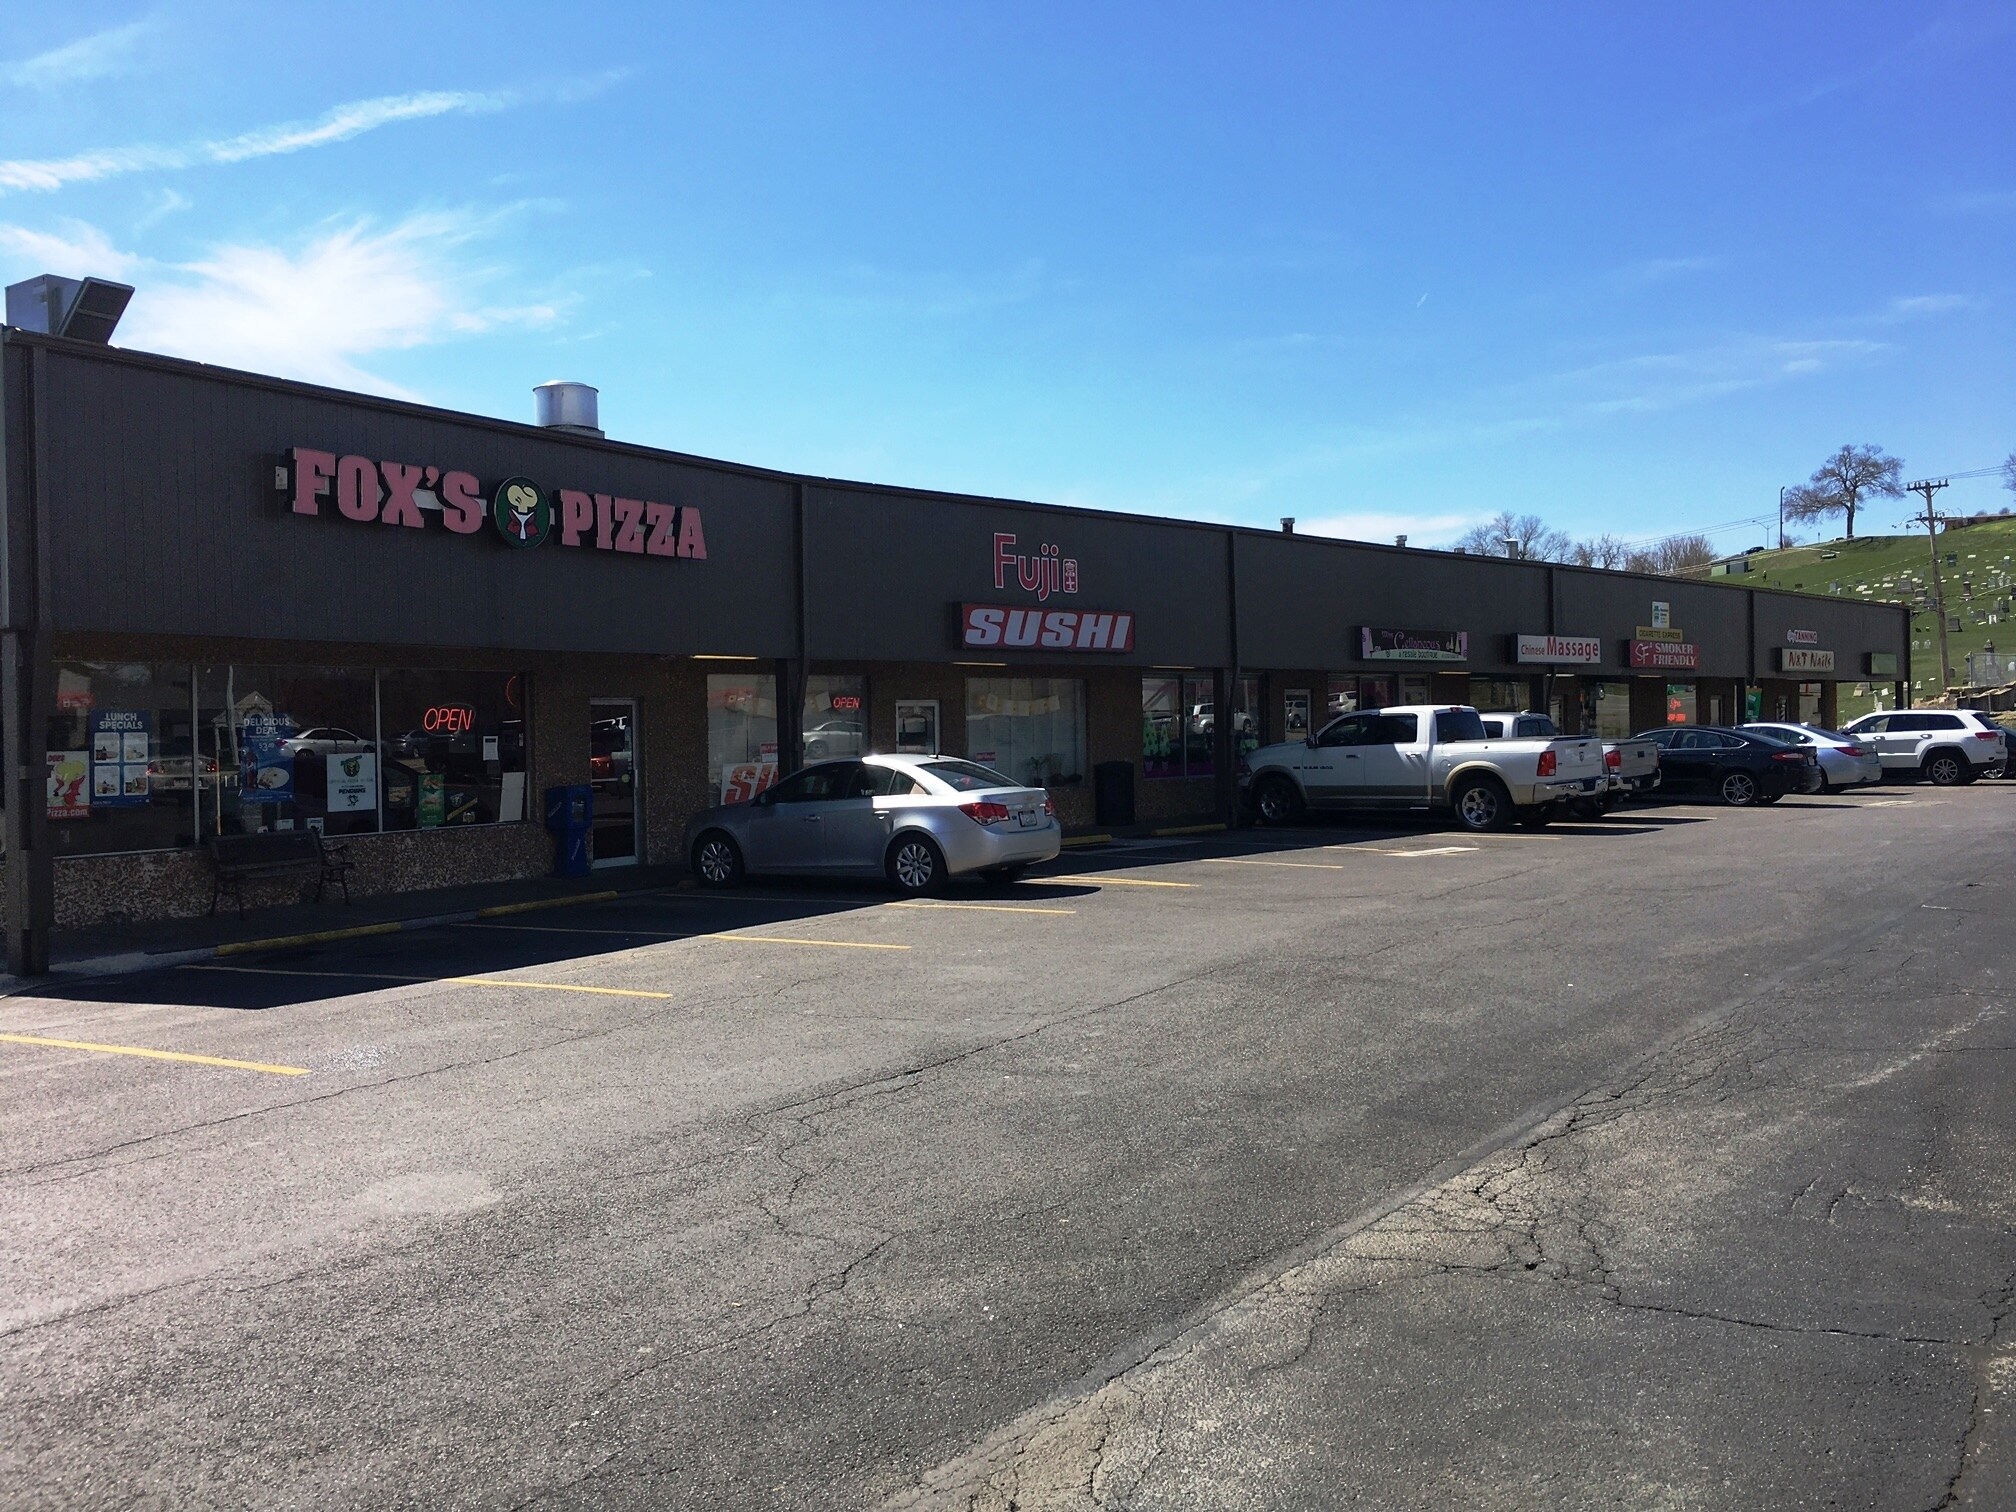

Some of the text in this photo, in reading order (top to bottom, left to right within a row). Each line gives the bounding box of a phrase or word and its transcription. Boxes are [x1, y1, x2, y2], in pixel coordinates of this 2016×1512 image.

[292, 446, 707, 560] FOX'S PIZZA
[993, 532, 1060, 602] Fuji
[964, 608, 1131, 649] SUSHI
[1521, 636, 1599, 661] Chinese Massage
[1655, 643, 1693, 655] SMOKER
[1653, 654, 1697, 666] FRIENDLY
[1811, 653, 1831, 669] Nails
[832, 696, 860, 709] OPEN
[105, 713, 137, 721] LUNCH
[243, 717, 290, 727] DELICIOUS
[424, 708, 474, 731] OPEN
[99, 721, 143, 730] SPECIALS
[255, 727, 279, 735] DEAL
